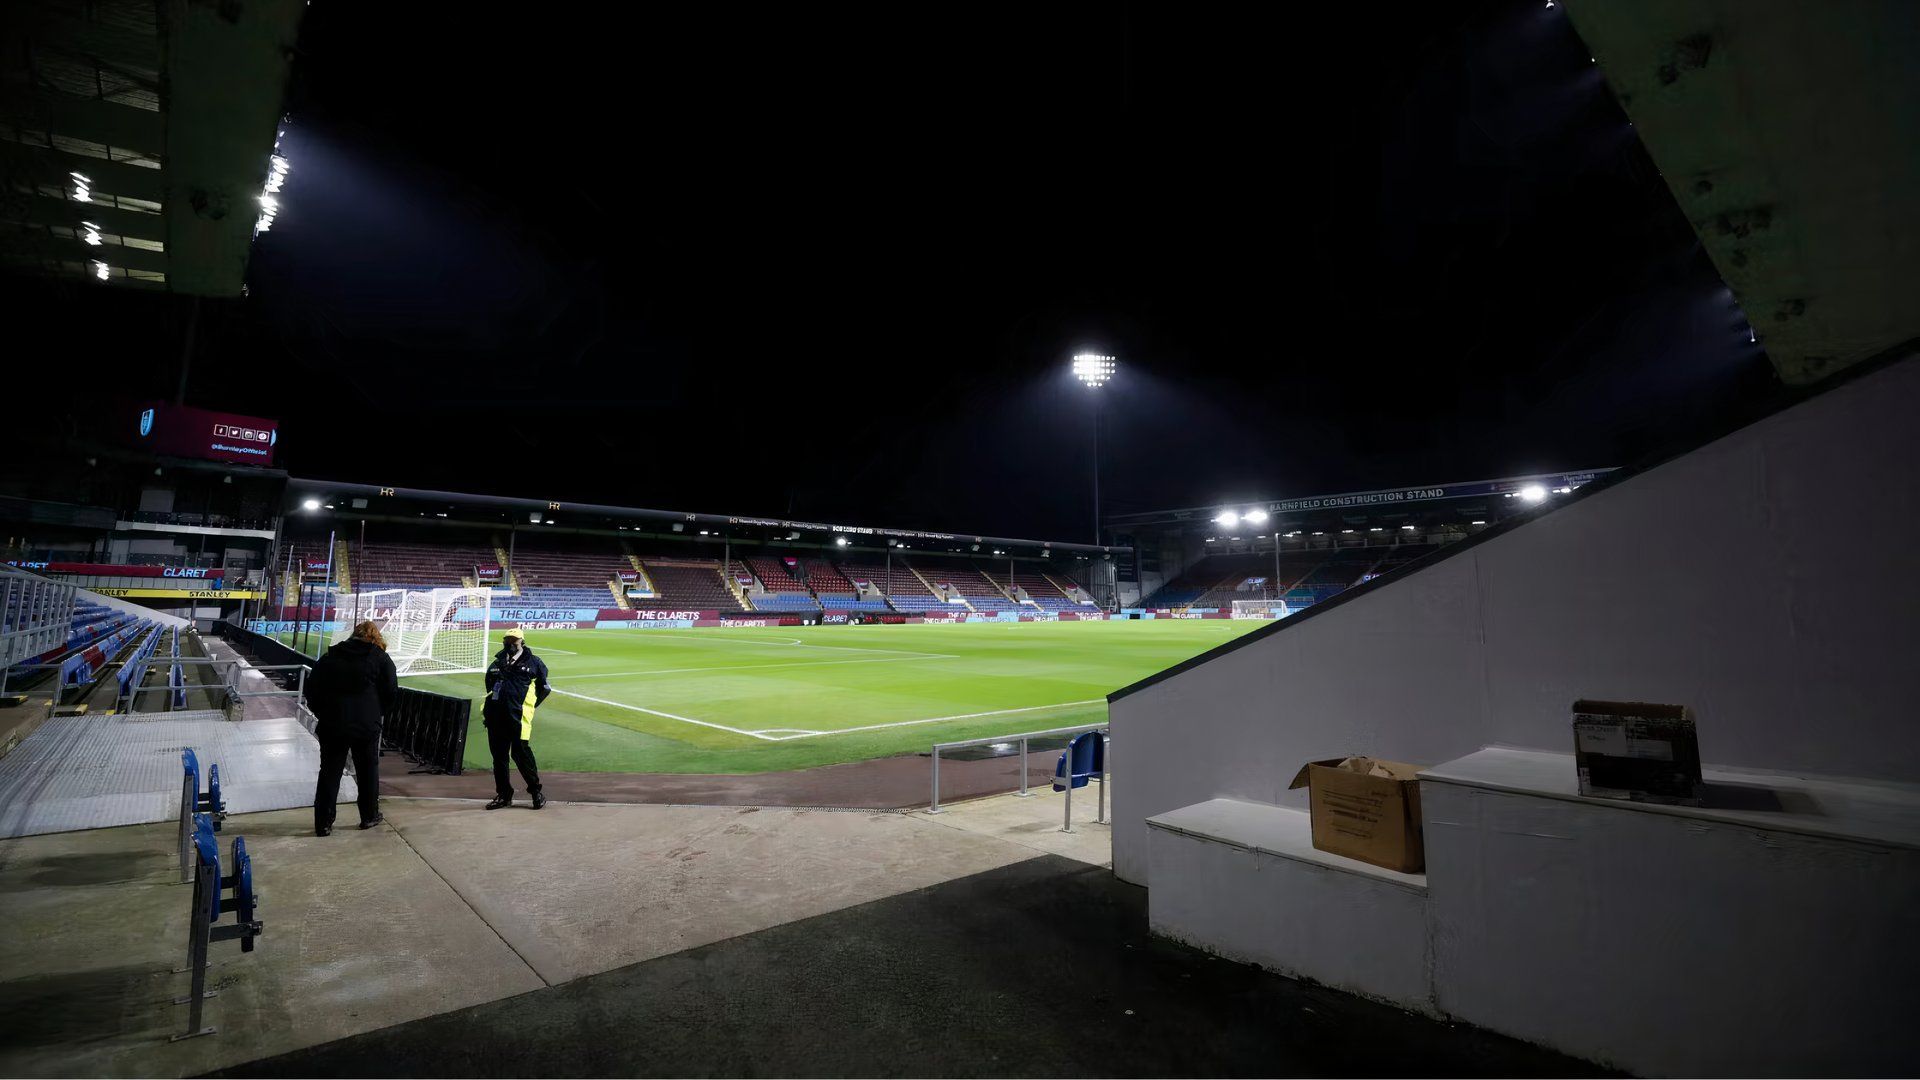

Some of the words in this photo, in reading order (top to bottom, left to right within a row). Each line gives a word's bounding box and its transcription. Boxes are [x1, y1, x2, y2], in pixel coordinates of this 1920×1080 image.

[380, 487, 394, 497] HR
[1323, 492, 1403, 507] CONSTRUCTION
[1407, 488, 1444, 500] STAND
[549, 502, 560, 511] HR
[163, 567, 208, 578] CLARET
[500, 610, 523, 619] THE
[525, 610, 576, 620] CLARETS
[636, 610, 656, 620] THE
[657, 611, 700, 620] CLARETS
[517, 622, 535, 630] THE
[536, 622, 577, 630] CLARETS
[720, 620, 734, 628] THE
[735, 620, 766, 628] CLARETS
